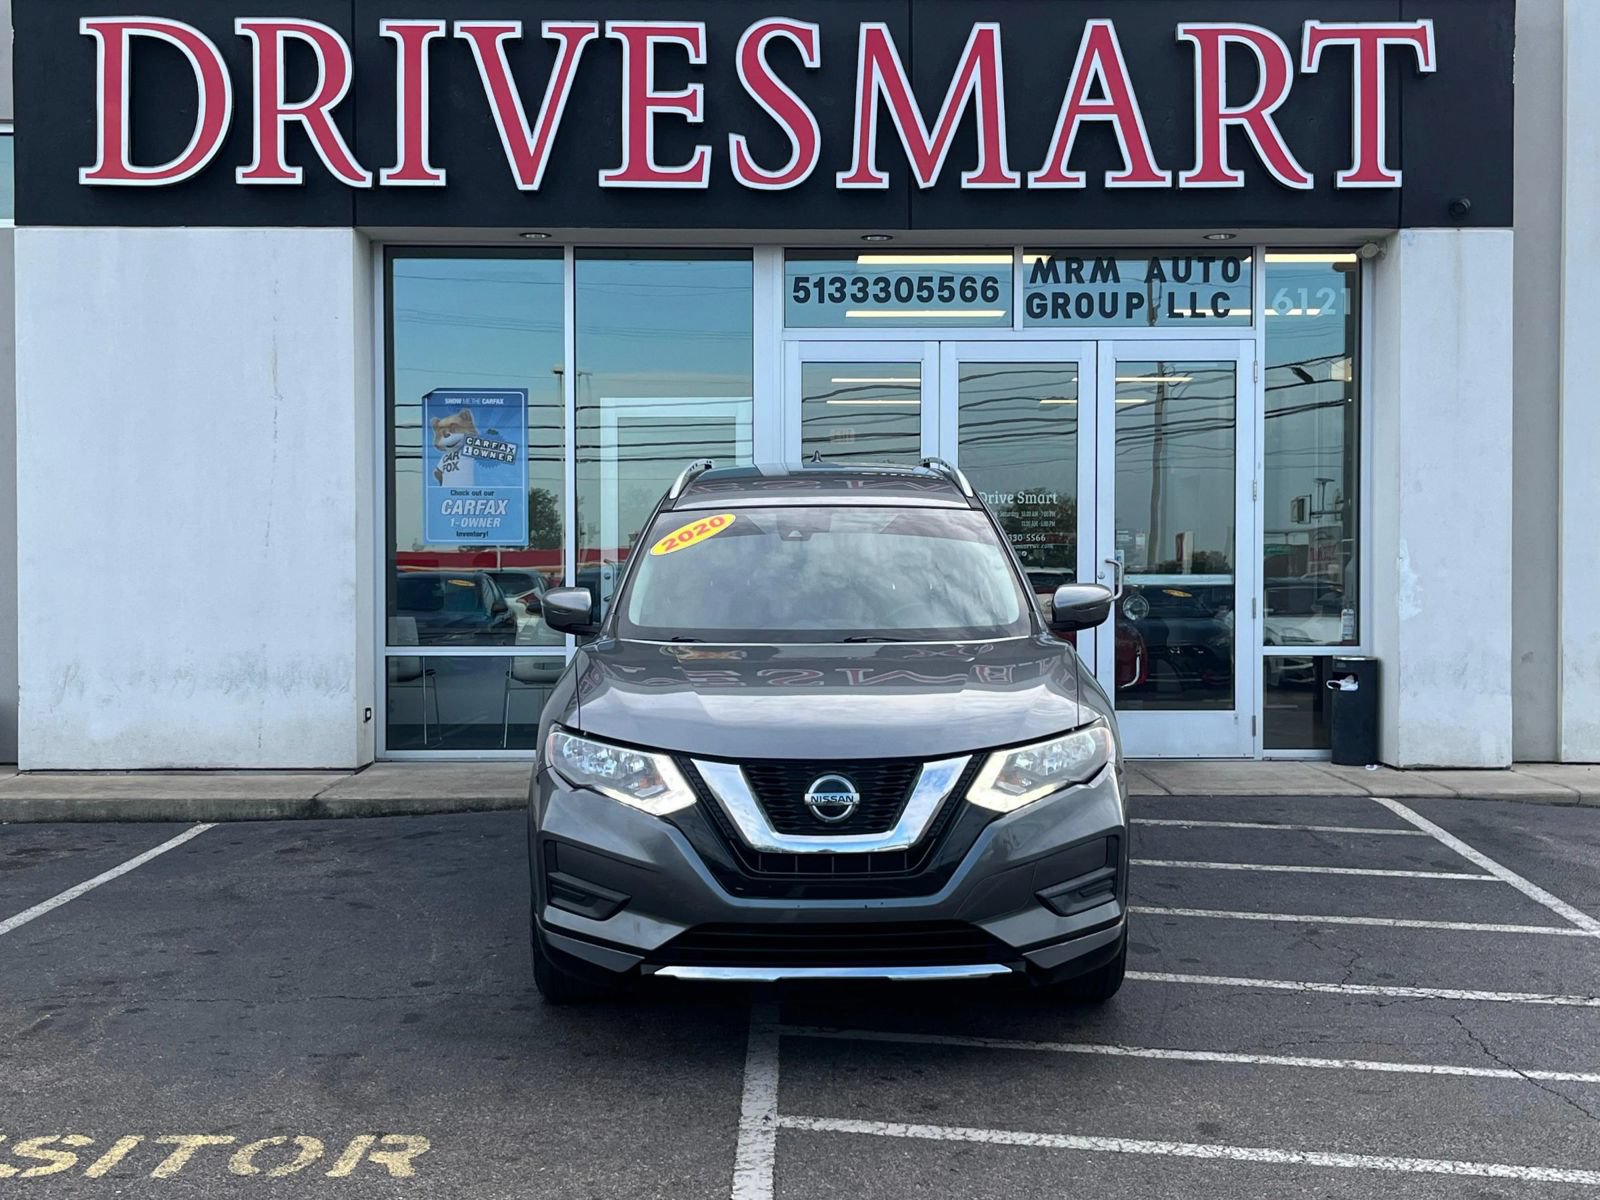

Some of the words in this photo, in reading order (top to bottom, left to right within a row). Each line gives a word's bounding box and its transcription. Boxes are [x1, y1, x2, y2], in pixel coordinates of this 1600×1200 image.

[79, 16, 1437, 191] DRIVESMART
[1029, 256, 1121, 284] MRM
[1144, 255, 1242, 284] AUTO
[792, 275, 1000, 304] 5133305566
[1025, 292, 1145, 320] GROUP
[1167, 292, 1232, 319] LLC
[1271, 287, 1352, 316] 6121
[482, 397, 504, 405] CARFAX
[465, 436, 517, 455] CARFAX
[442, 452, 461, 464] CAR
[472, 448, 514, 463] OWNER
[443, 461, 460, 473] FOX
[450, 489, 470, 497] Check
[979, 490, 1015, 504] Drive
[1017, 491, 1058, 504] Smart
[441, 499, 508, 516] CARFAX
[449, 517, 502, 528] 1-OWNER
[456, 530, 489, 539] Inventory!
[661, 515, 726, 552] 2020
[1026, 533, 1046, 542] 5566
[810, 795, 854, 803] NISSAN
[0, 1134, 431, 1178] SITOR
